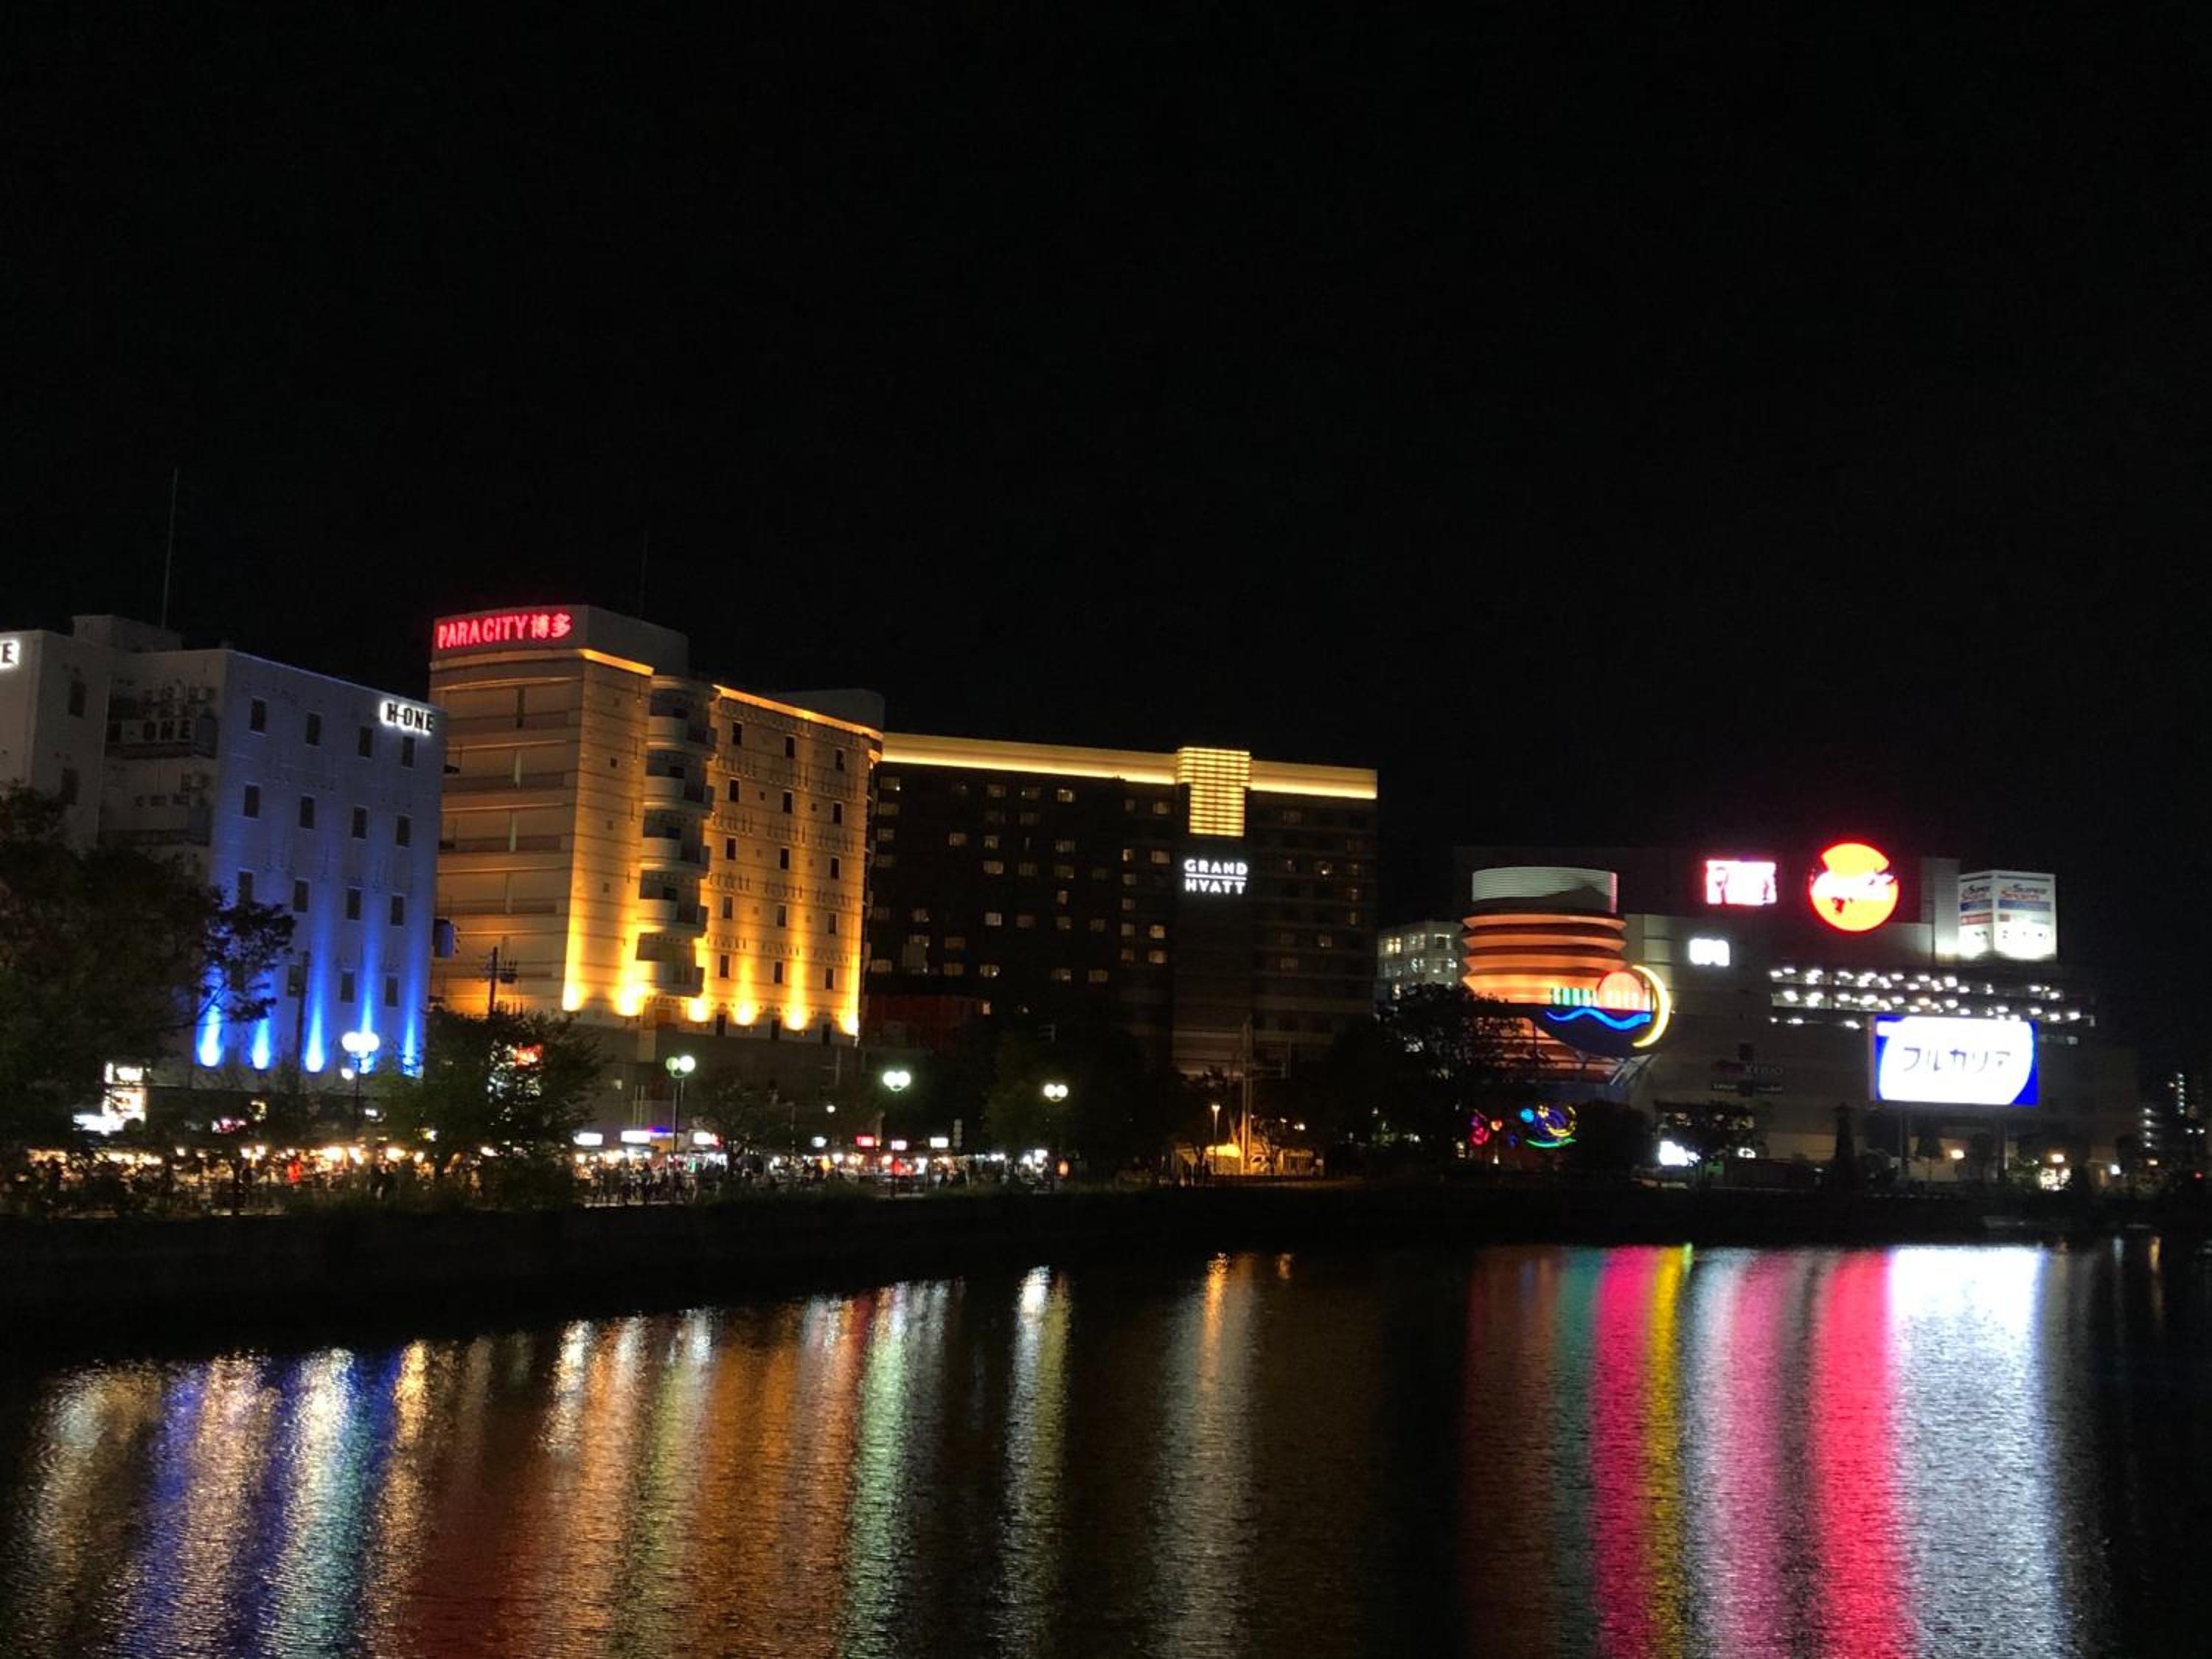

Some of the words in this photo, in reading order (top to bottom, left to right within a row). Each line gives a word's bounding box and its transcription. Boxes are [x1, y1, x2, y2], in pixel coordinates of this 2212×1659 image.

[437, 615, 529, 649] PARACITY
[386, 703, 434, 732] H-ONE
[1184, 859, 1248, 875] GRAND
[1185, 879, 1246, 894] HYATT
